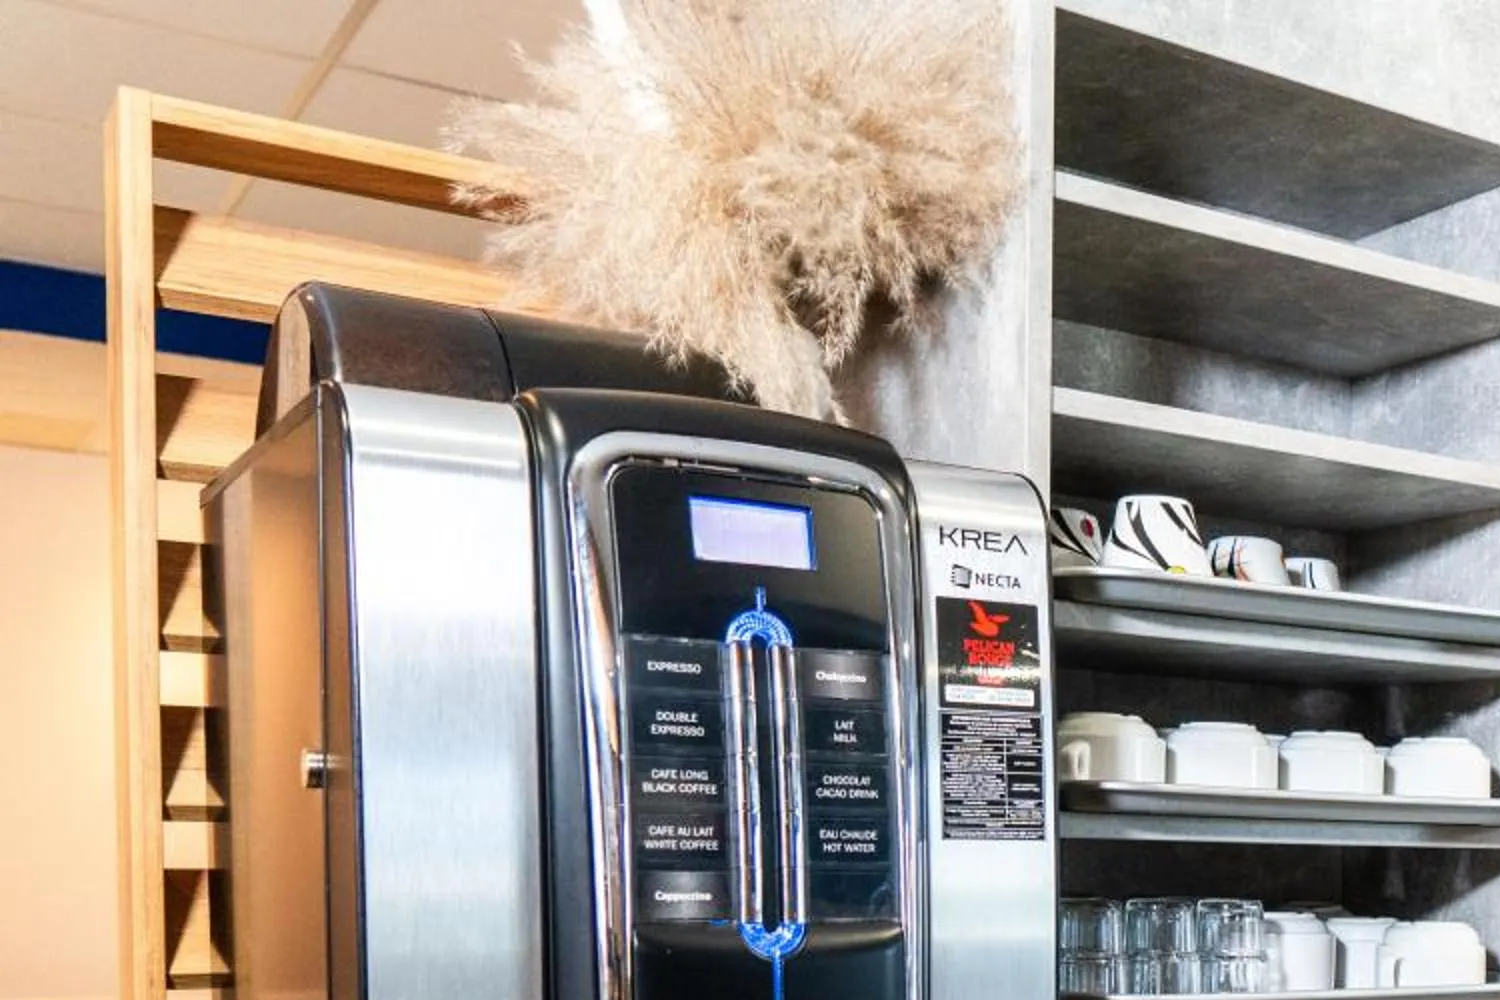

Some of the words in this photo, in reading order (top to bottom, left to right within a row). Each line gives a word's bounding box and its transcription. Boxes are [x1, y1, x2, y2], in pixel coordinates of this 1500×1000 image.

[938, 525, 1028, 556] KREA
[975, 572, 1022, 590] NECTA
[647, 661, 702, 674] EXPRESSO
[655, 710, 699, 723] DOUBLE
[650, 723, 705, 737] EXPRESSO
[835, 719, 855, 731] LAIT
[833, 732, 858, 743] MILK
[680, 769, 709, 781] LONG
[822, 774, 872, 787] CHOCOLAT
[641, 781, 677, 793] BLACK
[678, 783, 718, 795] COFFEE
[815, 787, 847, 799] CACAO
[848, 788, 879, 800] DRINK
[677, 826, 691, 837] AU
[693, 826, 714, 837] LAIT
[819, 828, 839, 839] EAU
[840, 829, 878, 841] CHAUDE
[643, 839, 678, 851] WHITE
[679, 839, 719, 852] COFFEE
[823, 842, 842, 853] HOT
[844, 842, 876, 854] WATER
